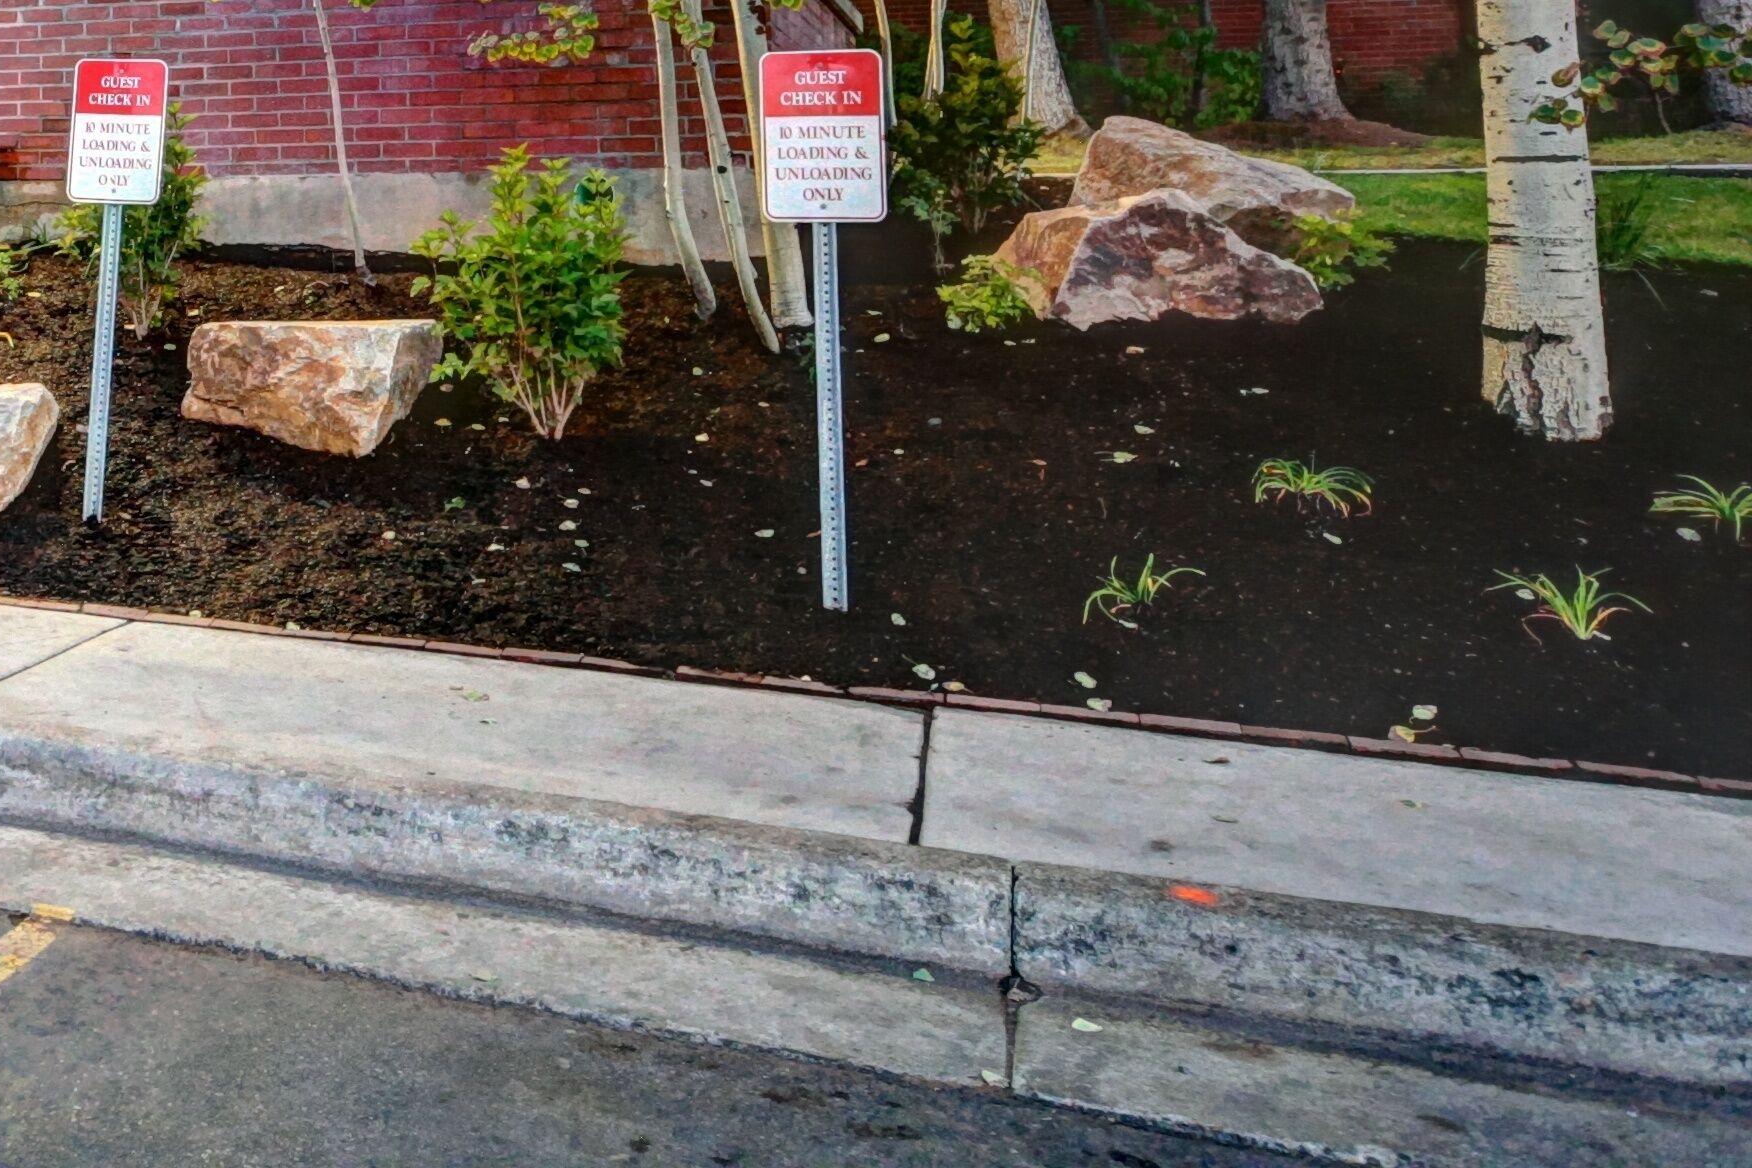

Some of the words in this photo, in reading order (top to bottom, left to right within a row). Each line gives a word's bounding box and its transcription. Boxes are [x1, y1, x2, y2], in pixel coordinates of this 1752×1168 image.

[101, 76, 141, 89] GUEST
[794, 70, 847, 85] GUEST
[88, 92, 132, 106] CHECK
[136, 93, 151, 107] IN
[780, 91, 837, 106] CHECK
[842, 90, 862, 105] IN
[85, 121, 96, 133] 10
[99, 122, 151, 135] MINUTE
[779, 126, 792, 140] 10
[798, 125, 866, 139] MINUTE
[82, 139, 136, 152] LOADING
[140, 141, 151, 153] &
[777, 146, 848, 160] LOADING
[854, 146, 871, 160] &
[79, 155, 153, 170] UNLOADING
[98, 174, 131, 187] ONLY
[775, 167, 873, 181] UNLOADING
[802, 187, 844, 202] ONLY
